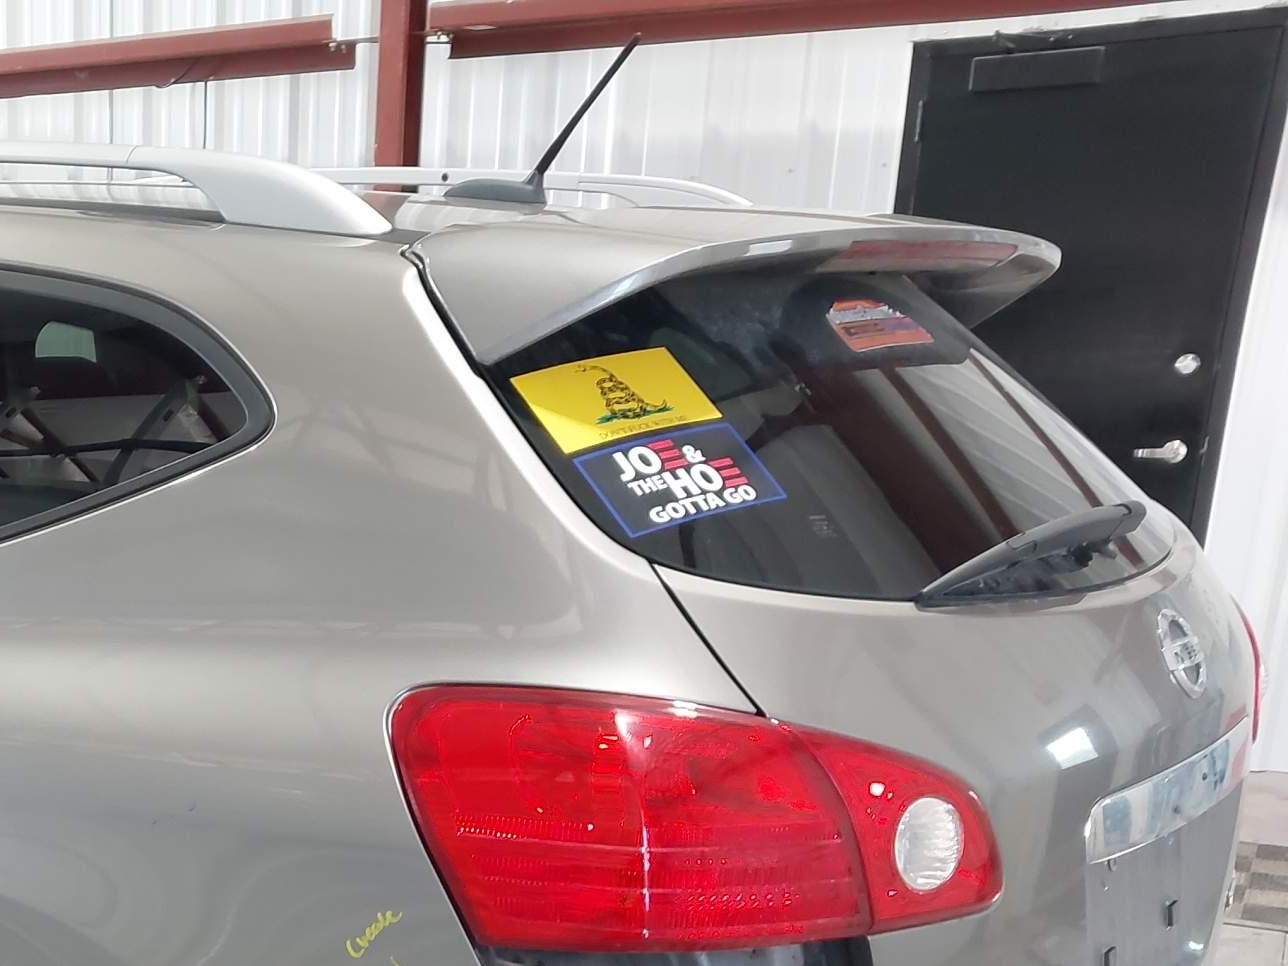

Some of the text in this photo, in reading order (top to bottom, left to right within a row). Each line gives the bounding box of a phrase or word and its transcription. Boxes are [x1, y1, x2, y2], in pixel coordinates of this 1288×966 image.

[612, 439, 706, 482] JOE &
[627, 457, 749, 499] THE HOE
[649, 484, 757, 523] GOTTA GO
